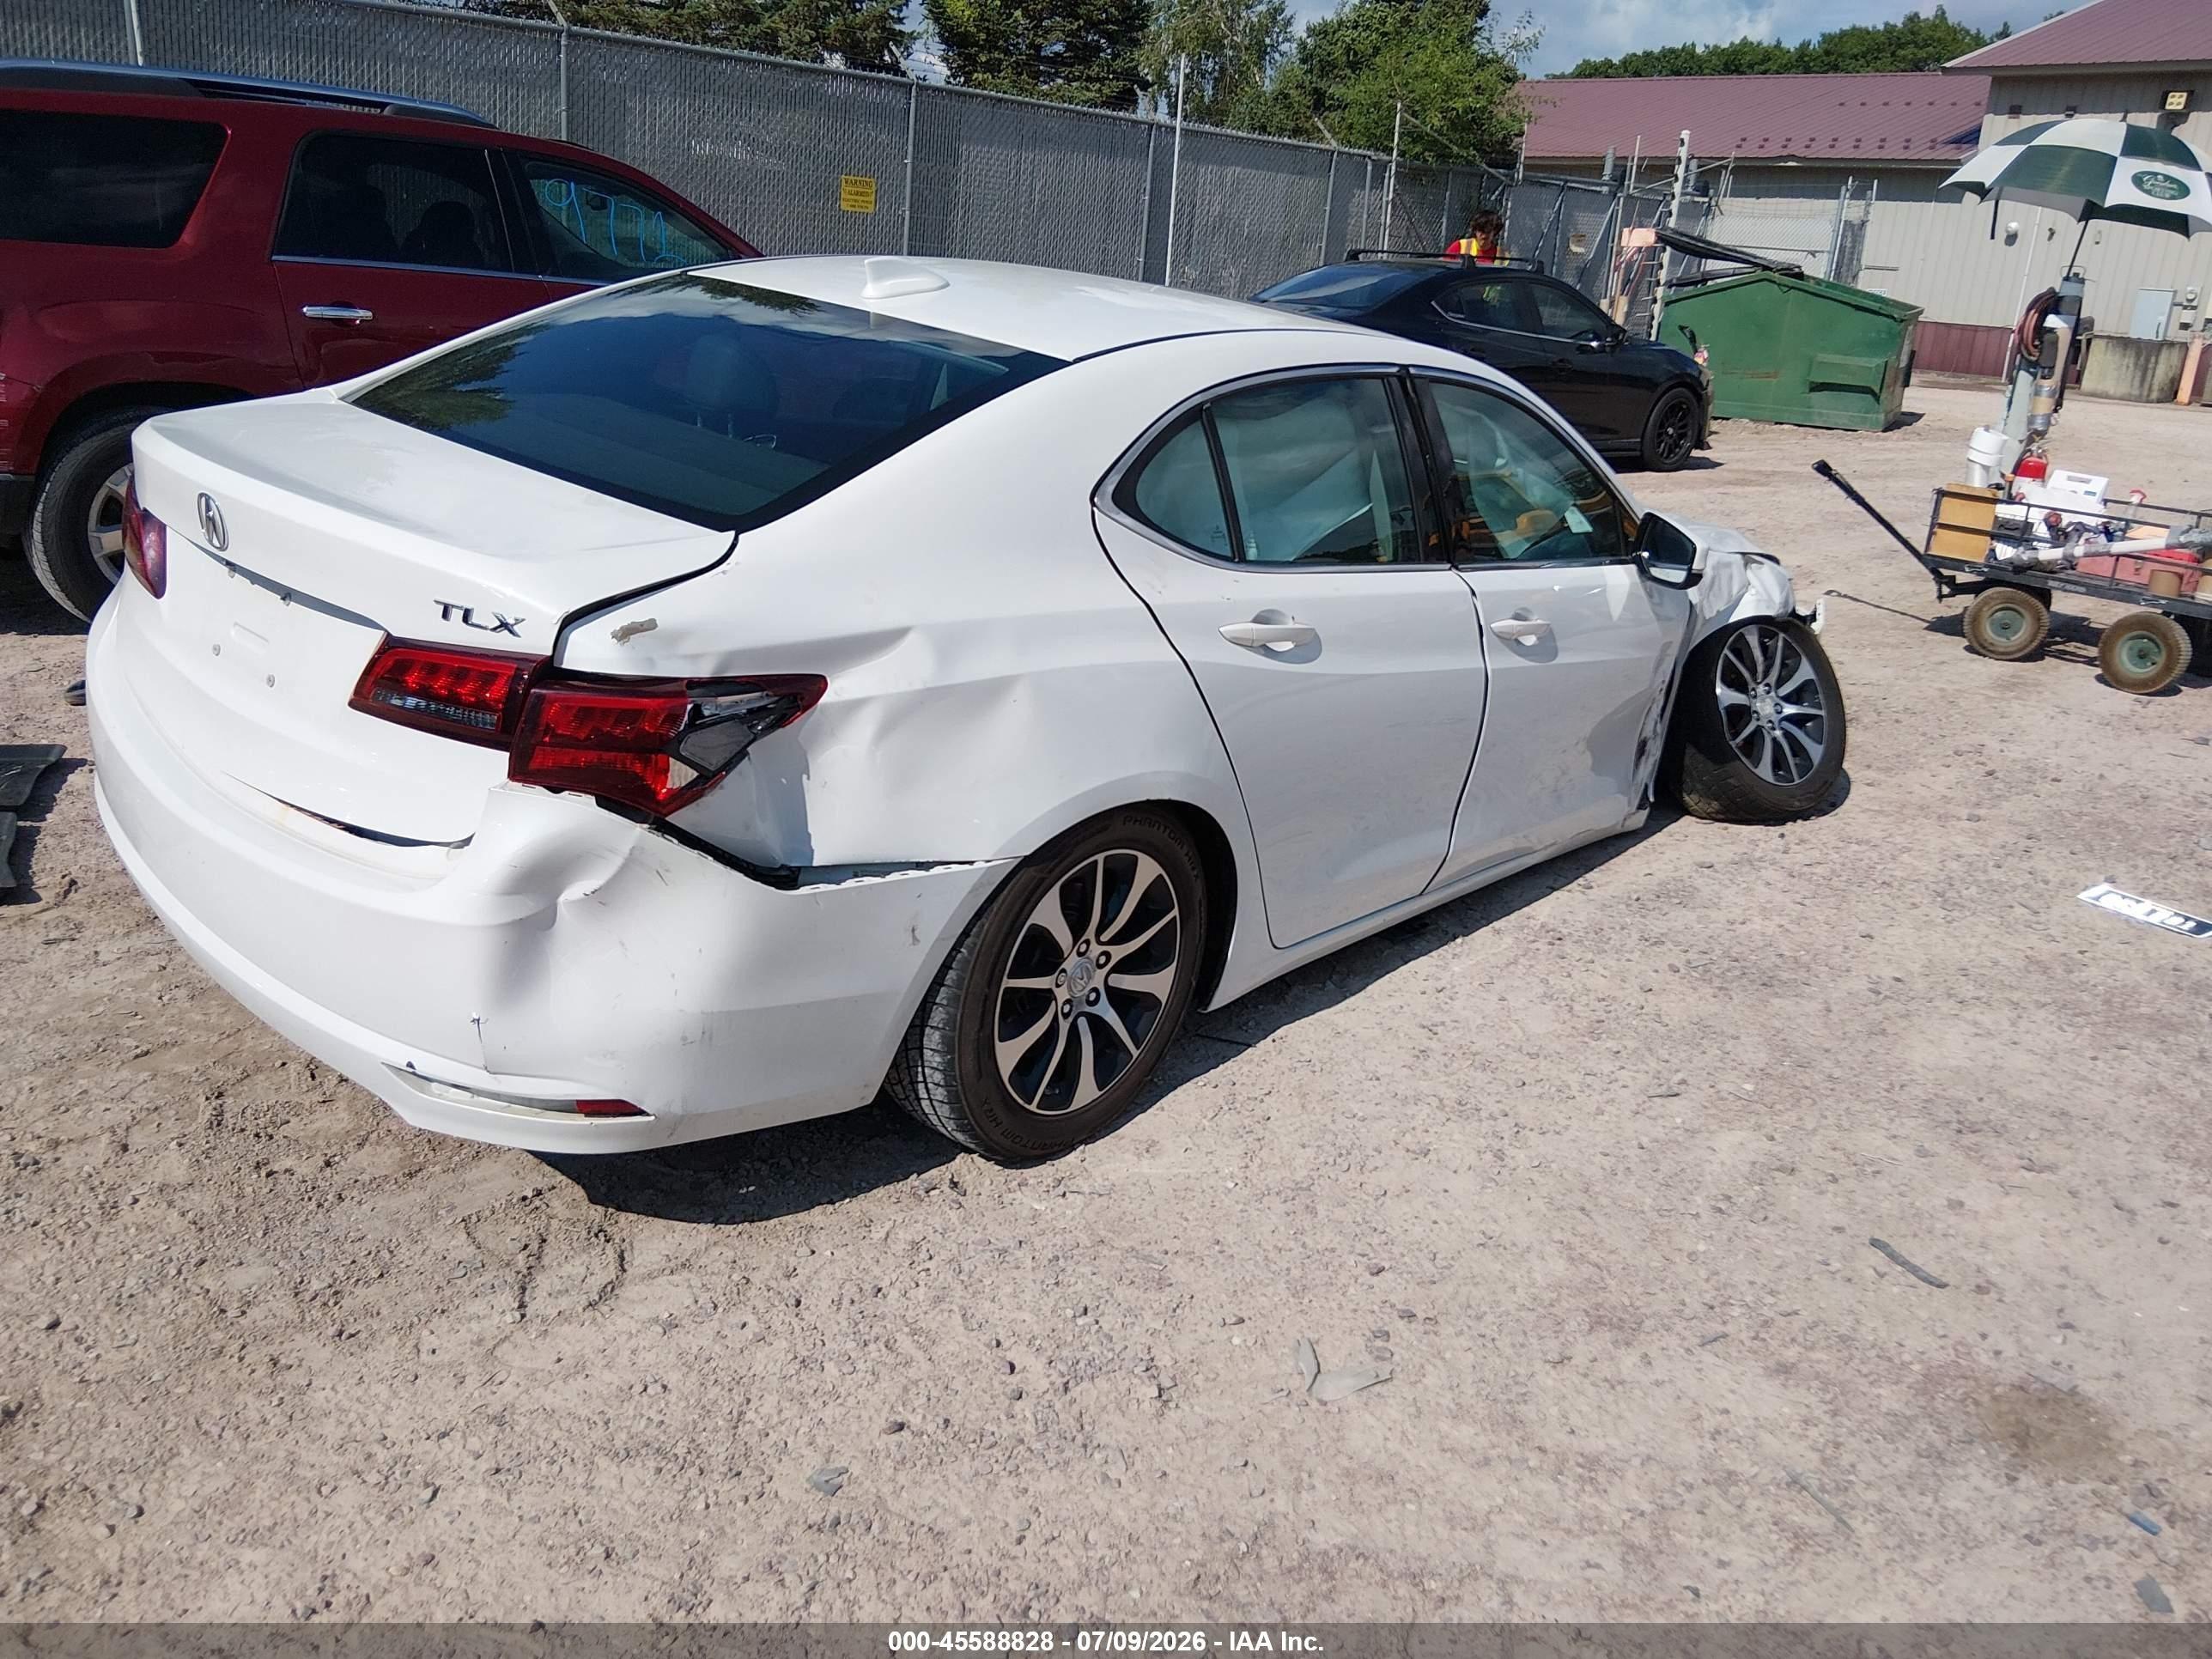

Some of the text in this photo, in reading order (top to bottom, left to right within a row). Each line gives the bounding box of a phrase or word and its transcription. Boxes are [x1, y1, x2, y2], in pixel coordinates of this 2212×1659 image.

[843, 178, 873, 188] WARNING
[433, 599, 526, 638] TLX
[1122, 814, 1185, 850] PHANTOM
[1000, 1127, 1076, 1150] PHANTOM
